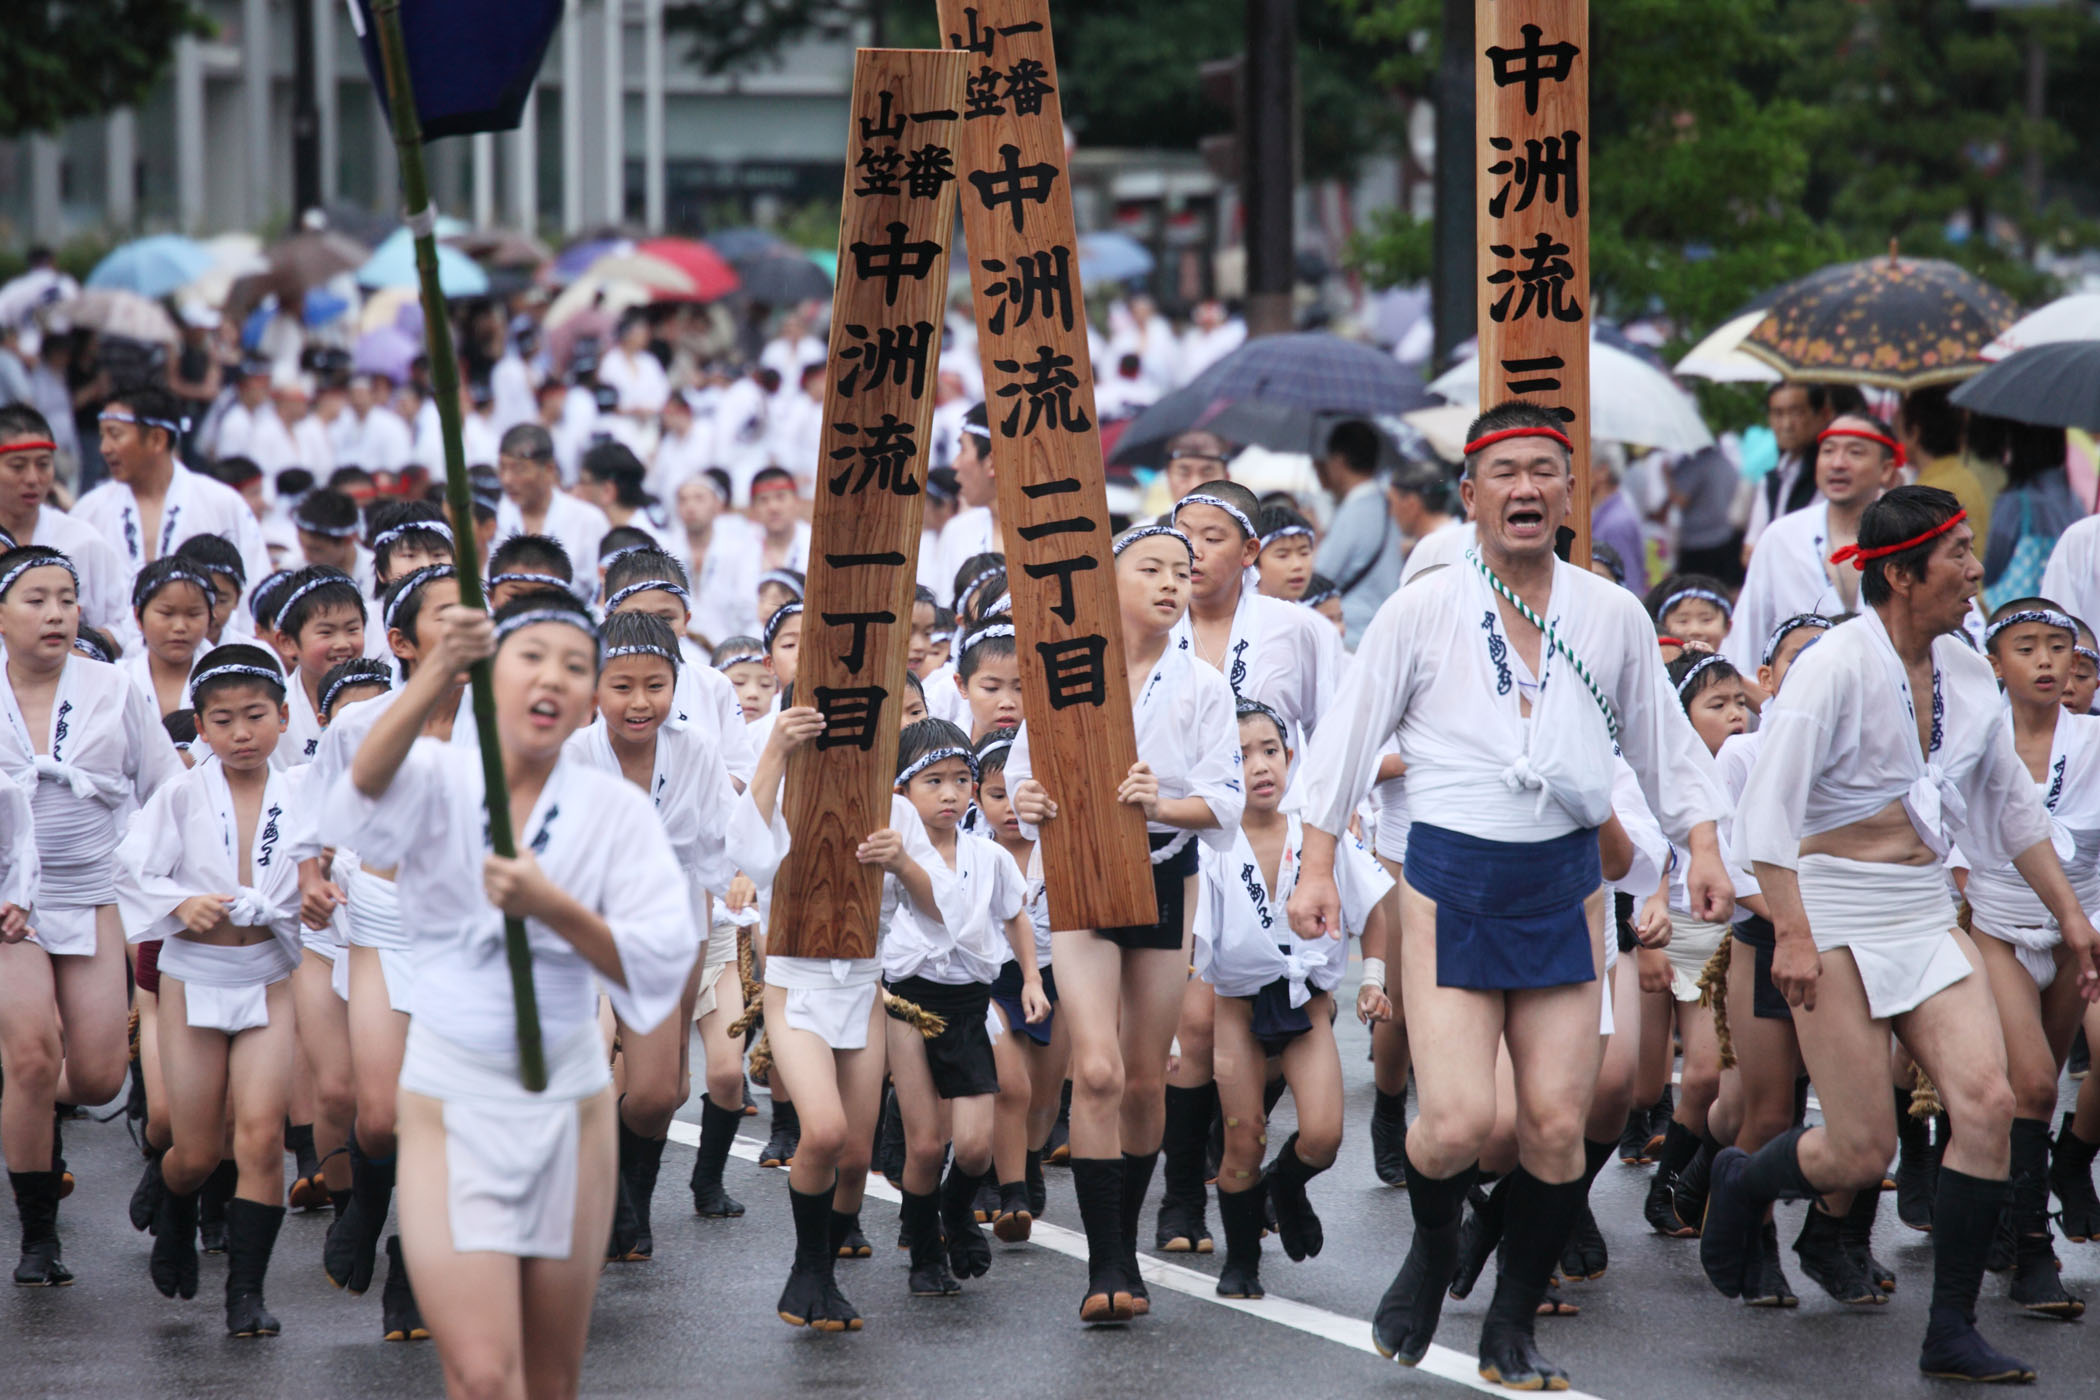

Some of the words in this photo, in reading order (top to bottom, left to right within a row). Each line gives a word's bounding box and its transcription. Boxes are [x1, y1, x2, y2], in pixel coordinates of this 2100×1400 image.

[813, 219, 943, 753] 中洲流一丁目
[967, 143, 1108, 711] 中洲流二丁目
